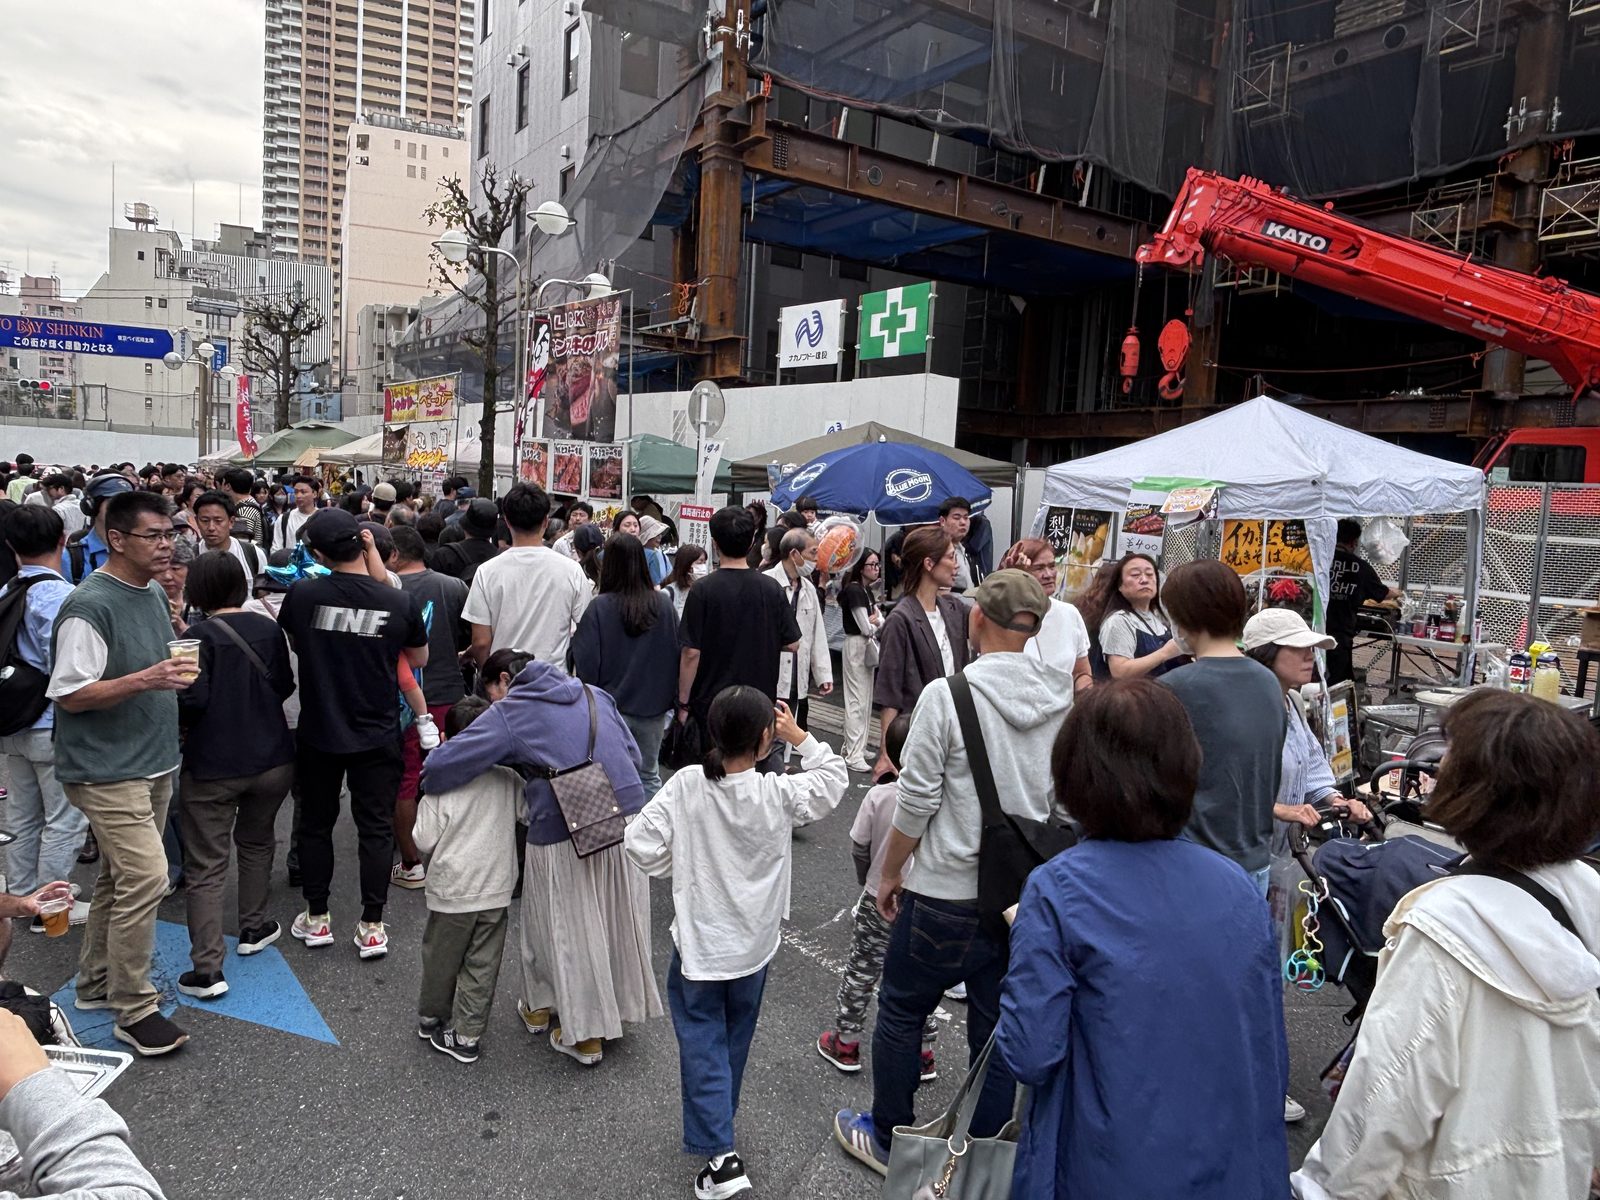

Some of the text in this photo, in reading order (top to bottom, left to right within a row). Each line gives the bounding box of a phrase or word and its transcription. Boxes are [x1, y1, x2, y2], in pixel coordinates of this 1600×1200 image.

[1266, 222, 1326, 251] KATO
[17, 318, 43, 336] BAY
[46, 323, 104, 339] SHINKIN
[13, 336, 114, 354] この街が輝く原動力となる
[888, 475, 929, 494] BLUE MOON
[1225, 521, 1278, 548] イカ墨
[1225, 549, 1283, 567] 焼きそば
[1331, 560, 1360, 573] RLD
